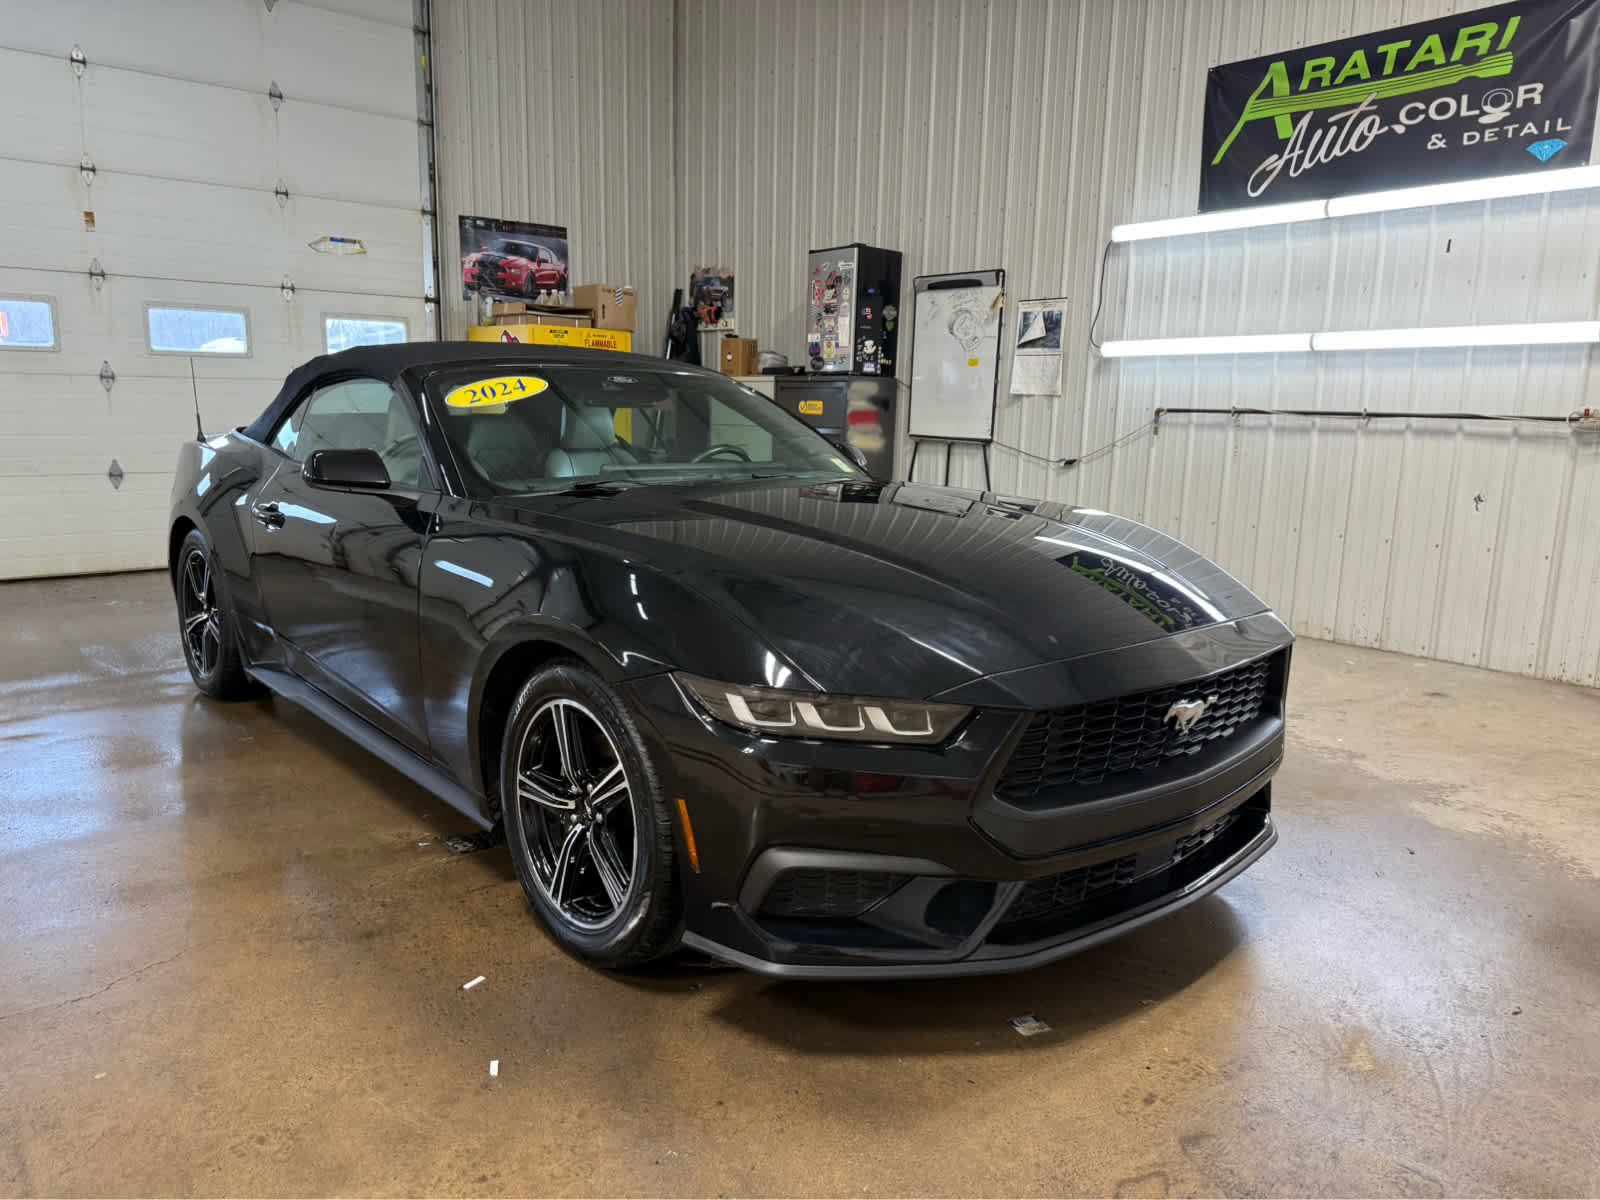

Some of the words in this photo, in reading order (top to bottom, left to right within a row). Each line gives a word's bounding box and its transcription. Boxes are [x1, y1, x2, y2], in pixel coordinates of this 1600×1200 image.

[1211, 16, 1521, 165] ARATARI
[1247, 92, 1389, 197] Auto
[1399, 82, 1544, 125] COLOR
[1427, 133, 1447, 150] &
[1463, 117, 1572, 147] DETAIL
[584, 338, 617, 350] FLAMMABLE
[464, 377, 527, 404] 2024
